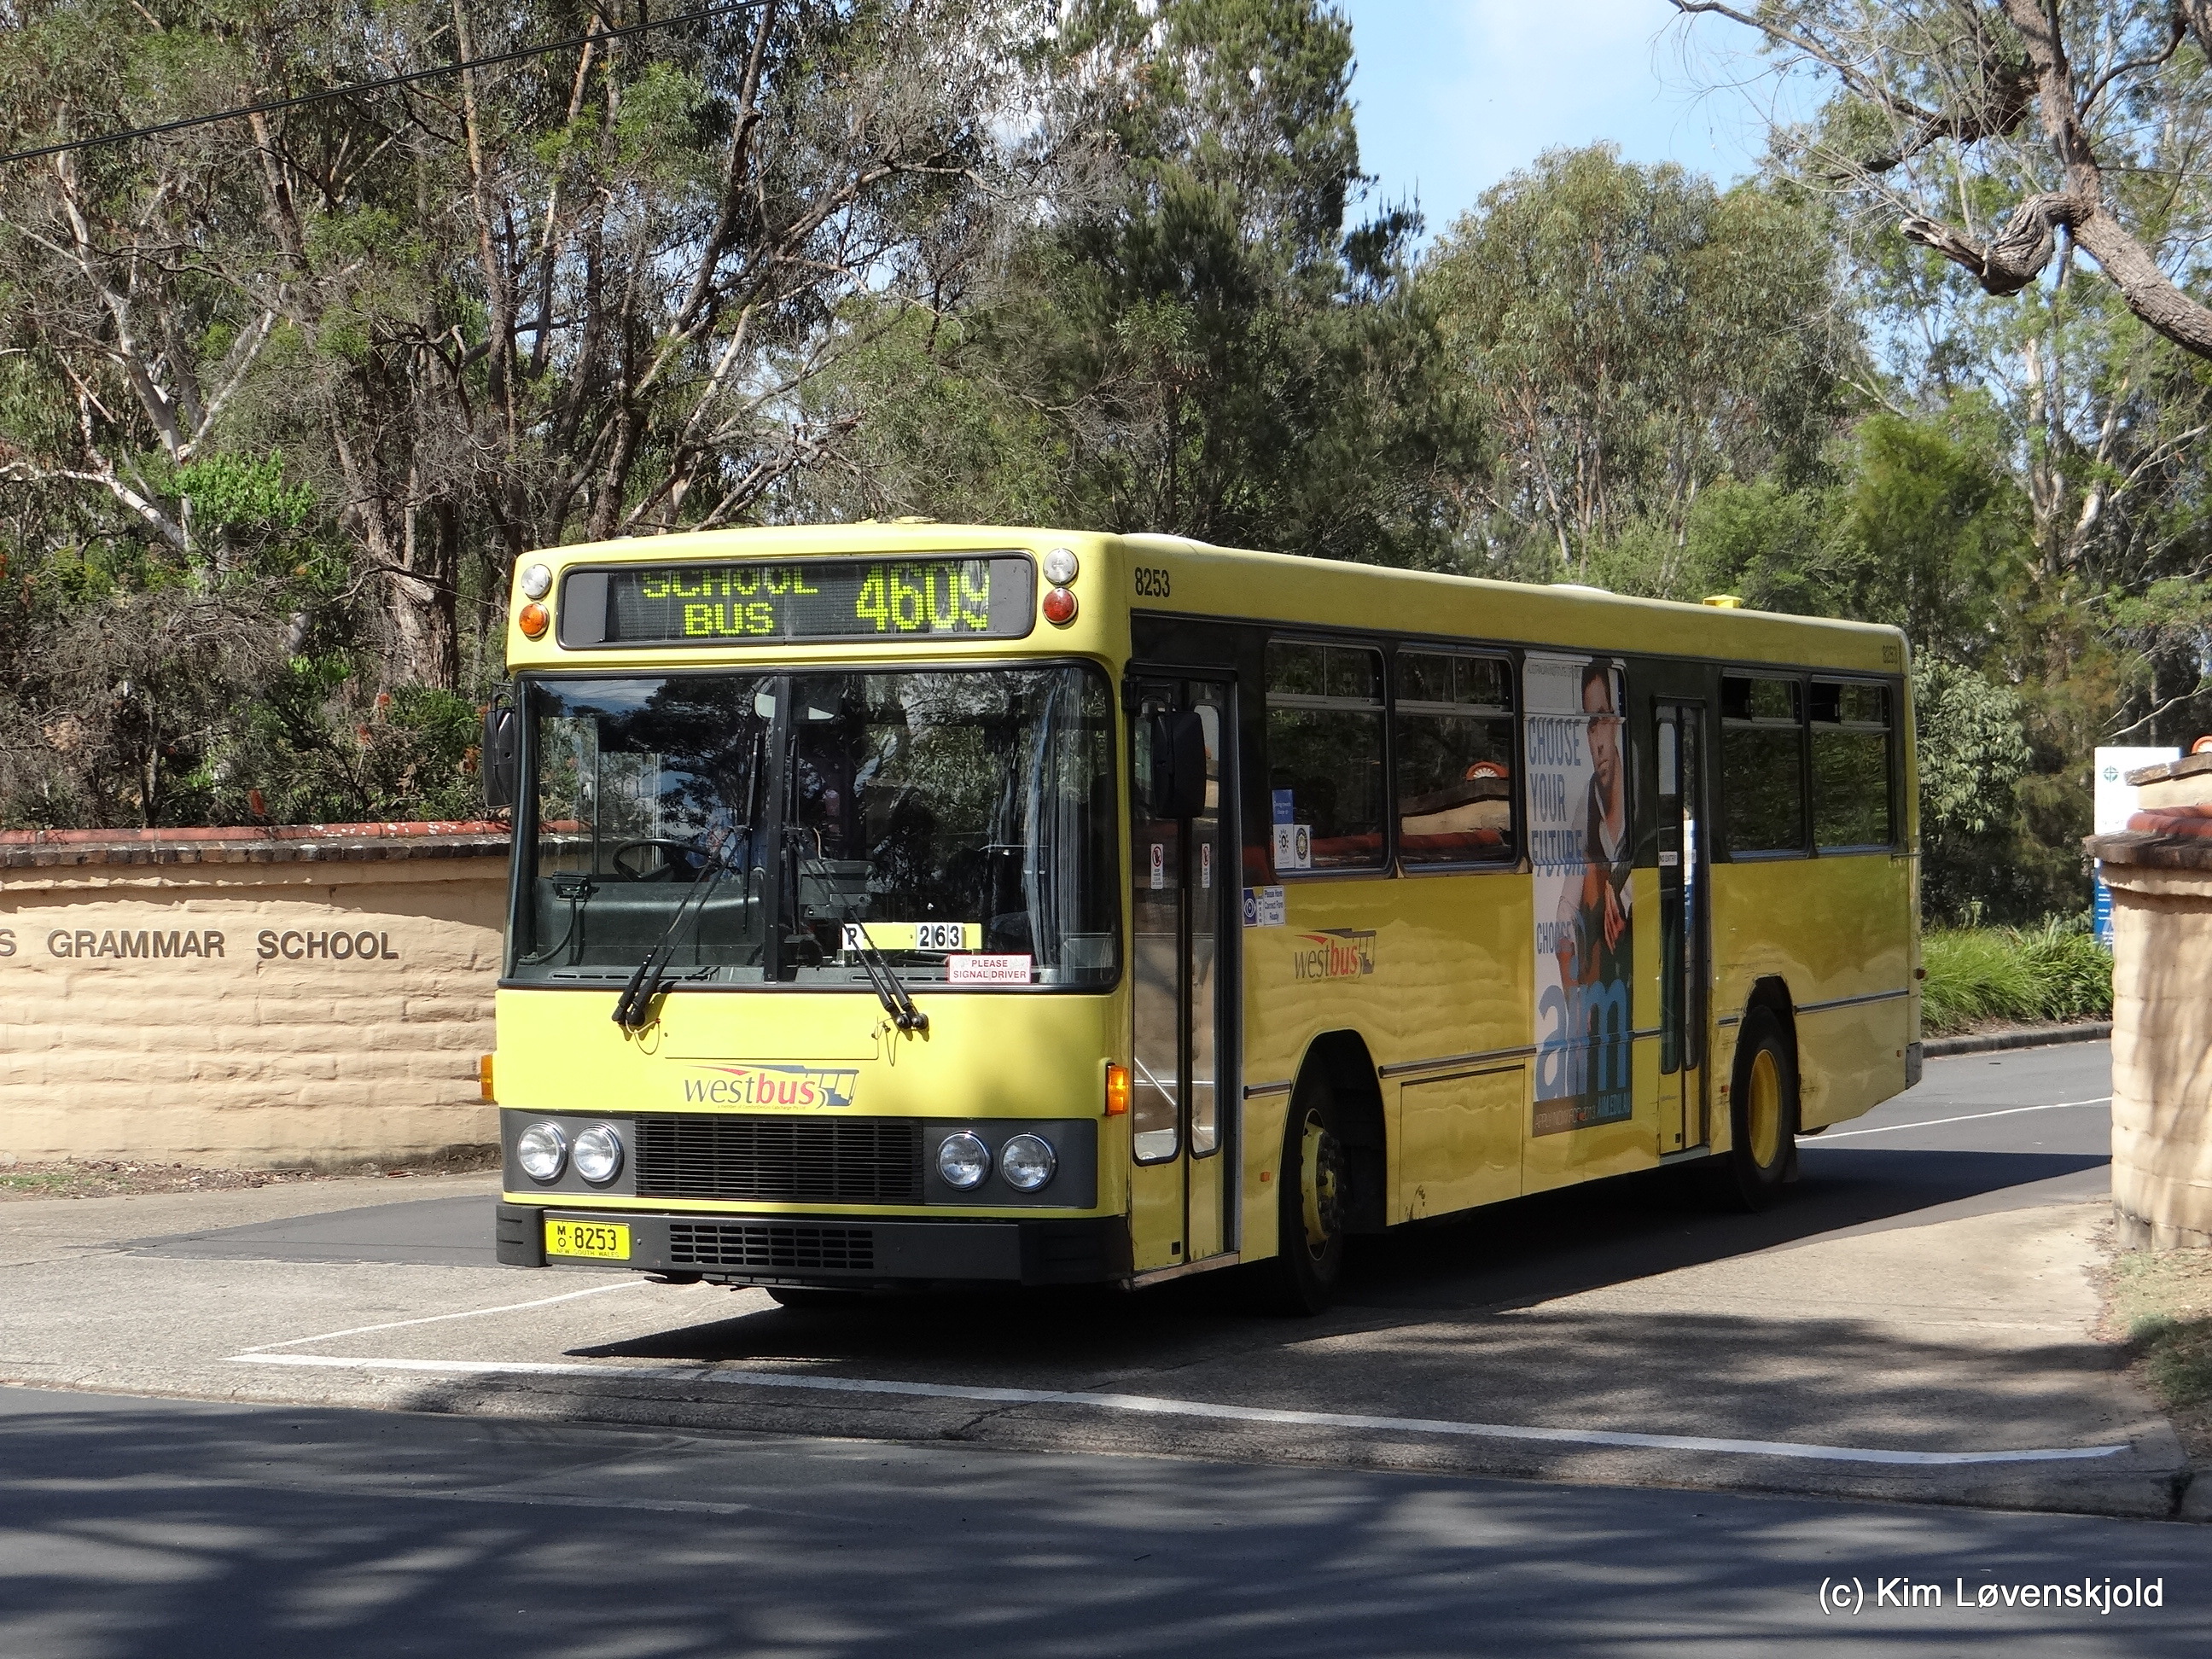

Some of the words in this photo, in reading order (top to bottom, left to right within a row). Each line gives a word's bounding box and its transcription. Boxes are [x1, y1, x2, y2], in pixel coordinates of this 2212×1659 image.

[643, 567, 818, 597] SCHOOL
[856, 562, 990, 631] 4609
[1134, 567, 1170, 597] 8253
[684, 602, 773, 635] BUS
[1528, 717, 1581, 766] CHOOSE
[1530, 773, 1567, 823] YOUR
[1531, 830, 1587, 877] FUTURE
[47, 929, 225, 958] GRAMMAR
[256, 929, 399, 960] SCHOOL
[919, 925, 960, 947] 263
[953, 970, 989, 979] SIGNAL
[991, 970, 1027, 979] DRIVER
[971, 959, 1009, 968] PLEASE
[1295, 940, 1358, 979] westbus
[684, 1073, 816, 1105] westbus
[575, 1226, 616, 1251] 8253
